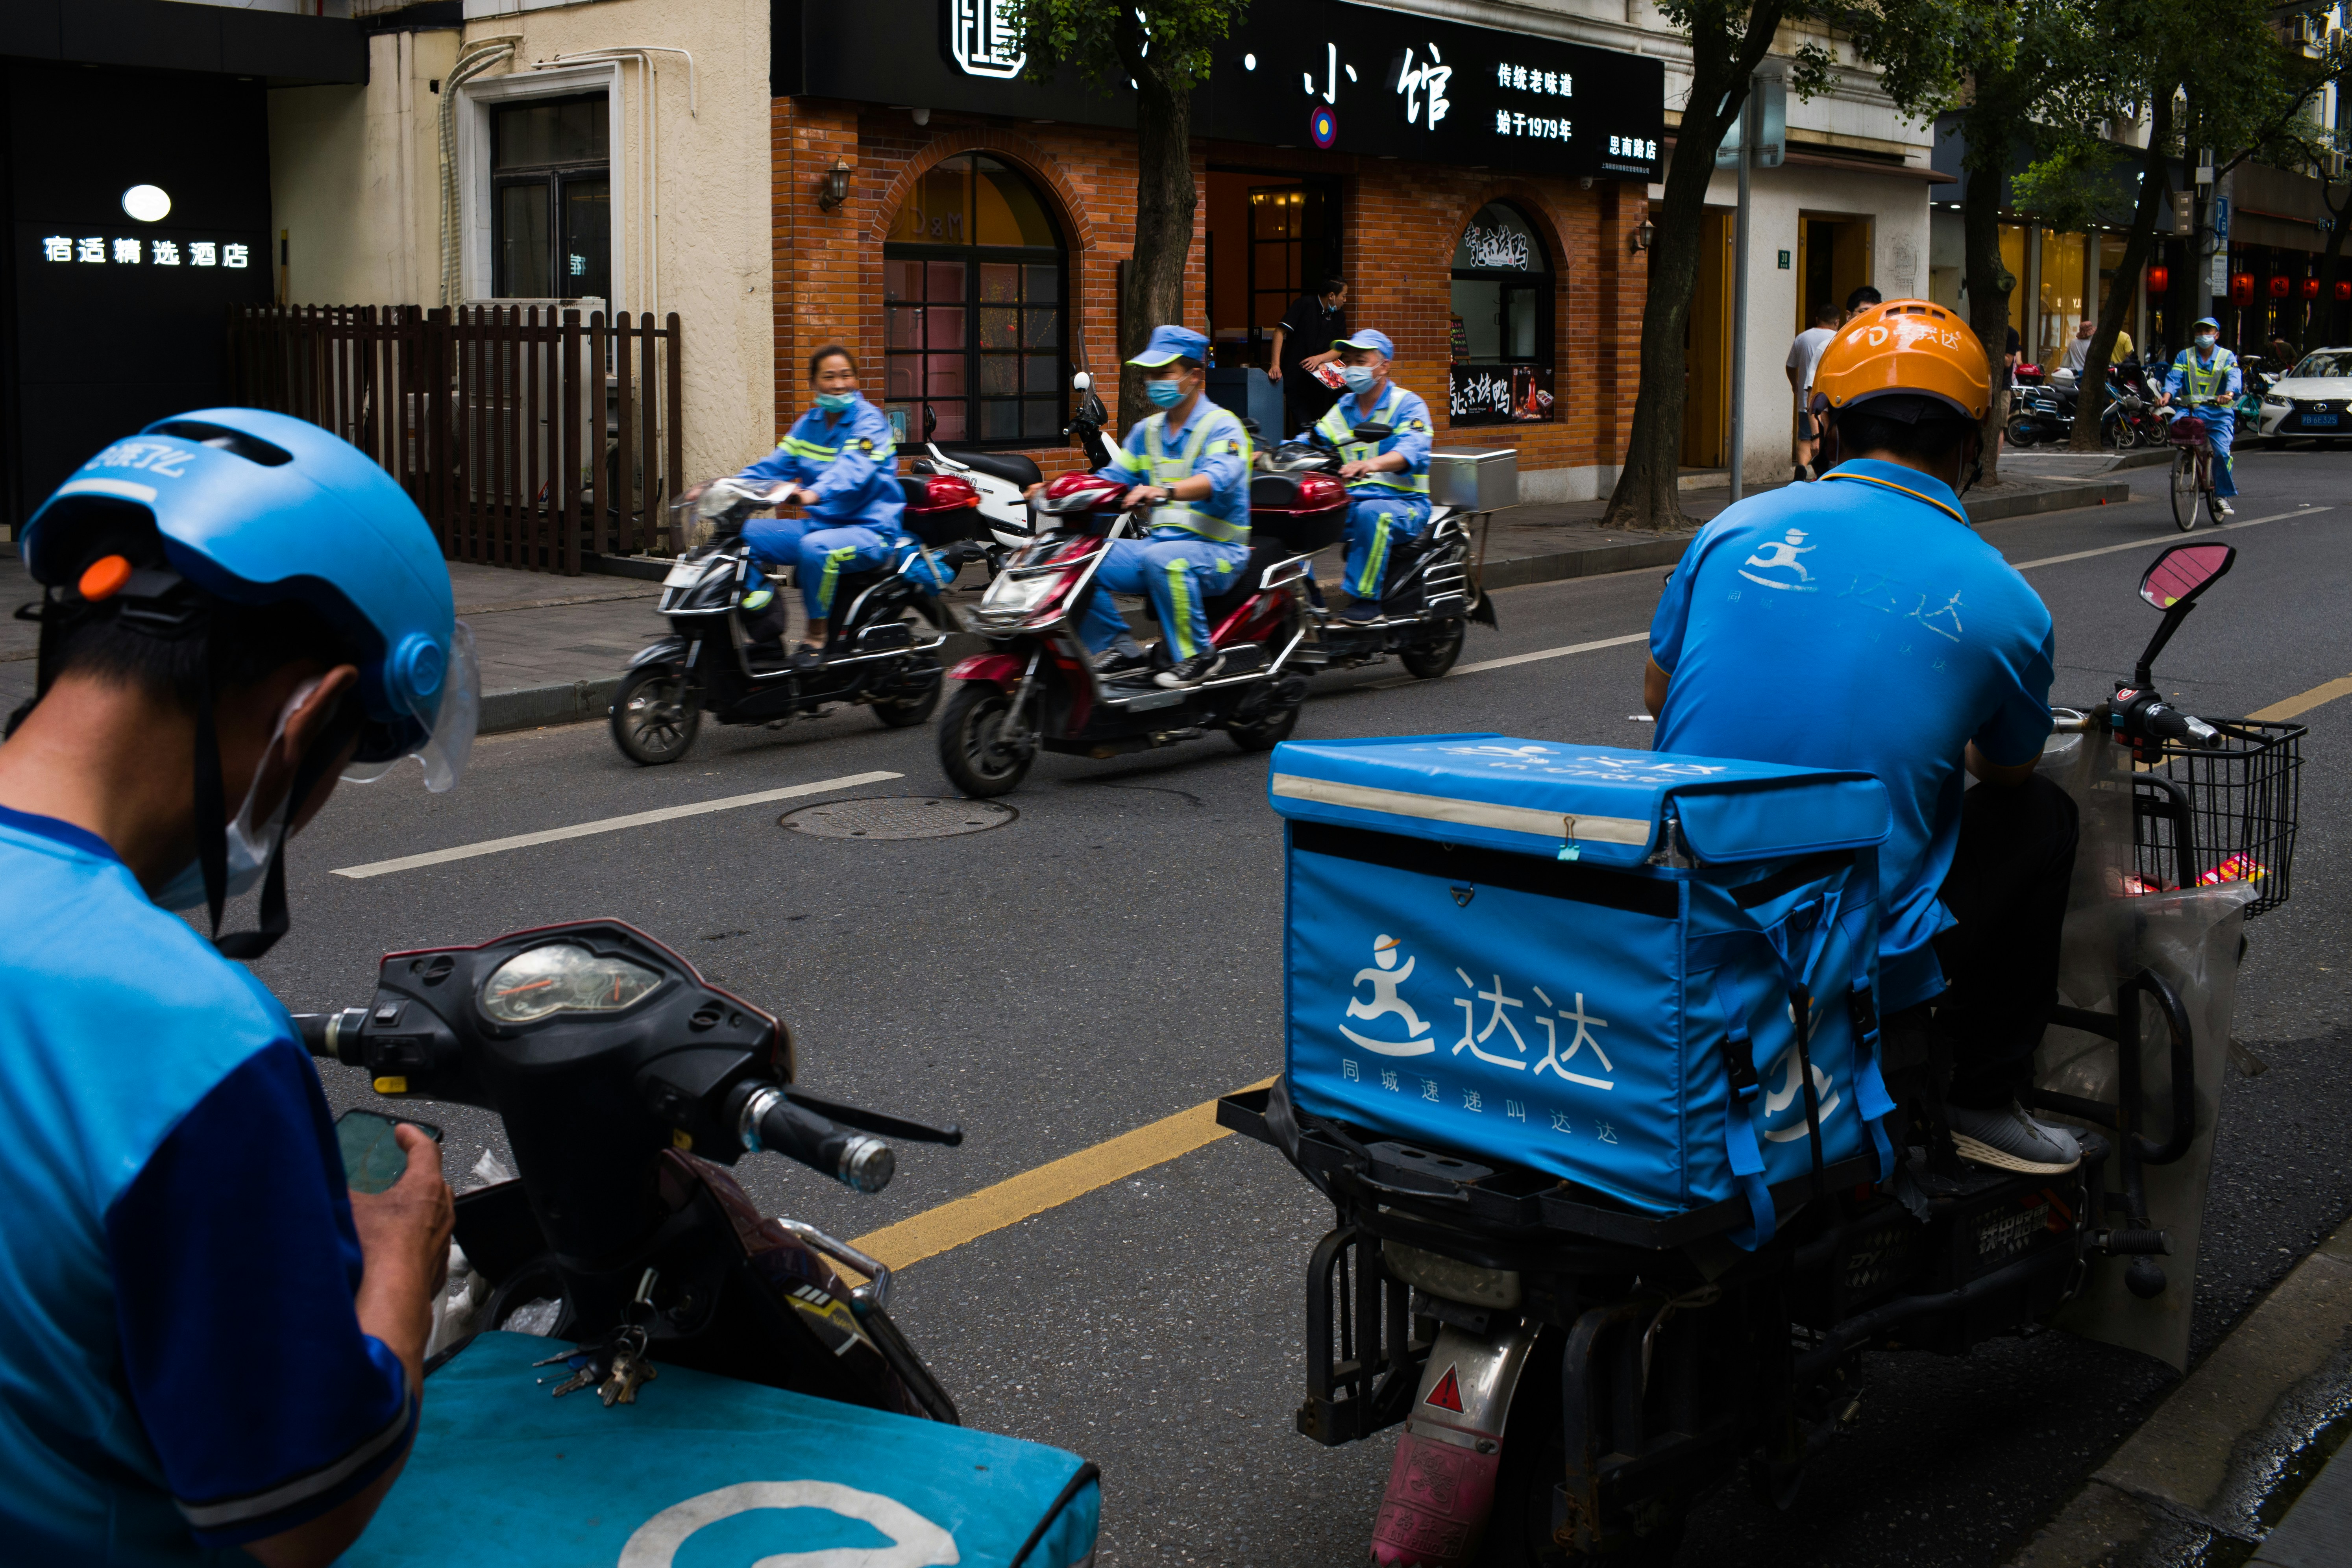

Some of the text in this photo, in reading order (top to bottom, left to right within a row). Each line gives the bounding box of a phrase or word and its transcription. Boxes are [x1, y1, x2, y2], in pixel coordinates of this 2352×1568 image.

[1498, 62, 1573, 97] 传统老味道
[1497, 110, 1572, 142] 始于1979年
[1610, 135, 1656, 160] 思南路店
[44, 236, 248, 268] 宿适精选酒店
[1465, 222, 1528, 270] 老北京烤鸭
[1781, 253, 1787, 263] 30
[1452, 967, 1614, 1090] 达达
[1343, 1059, 1618, 1144] 同城速递叫达达
[1383, 1511, 1461, 1544] 一路平安
[1388, 1529, 1403, 1543] LU
[1409, 1536, 1439, 1553] PING
